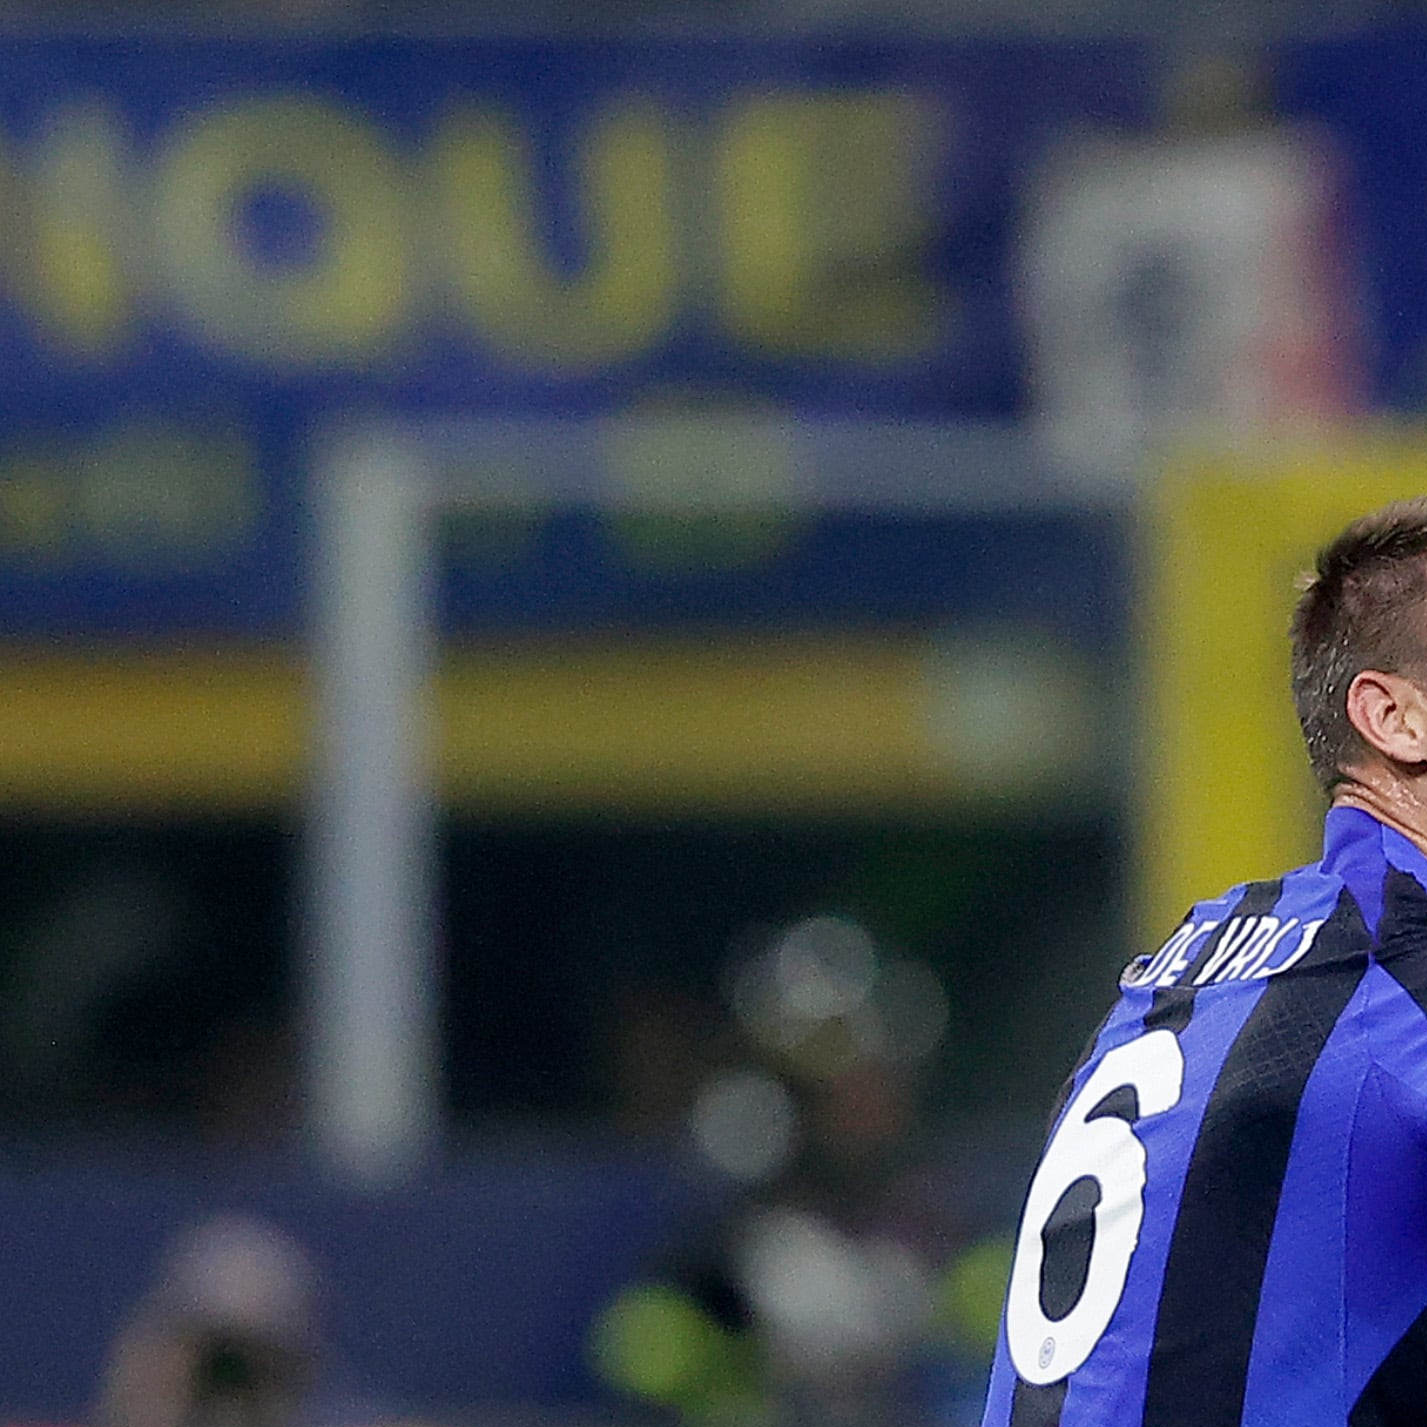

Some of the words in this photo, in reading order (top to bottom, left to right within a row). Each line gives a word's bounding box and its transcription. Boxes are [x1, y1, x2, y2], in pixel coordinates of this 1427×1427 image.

[1130, 920, 1221, 987] DE
[1193, 915, 1326, 986] VRIJ
[1006, 1029, 1185, 1386] 6
